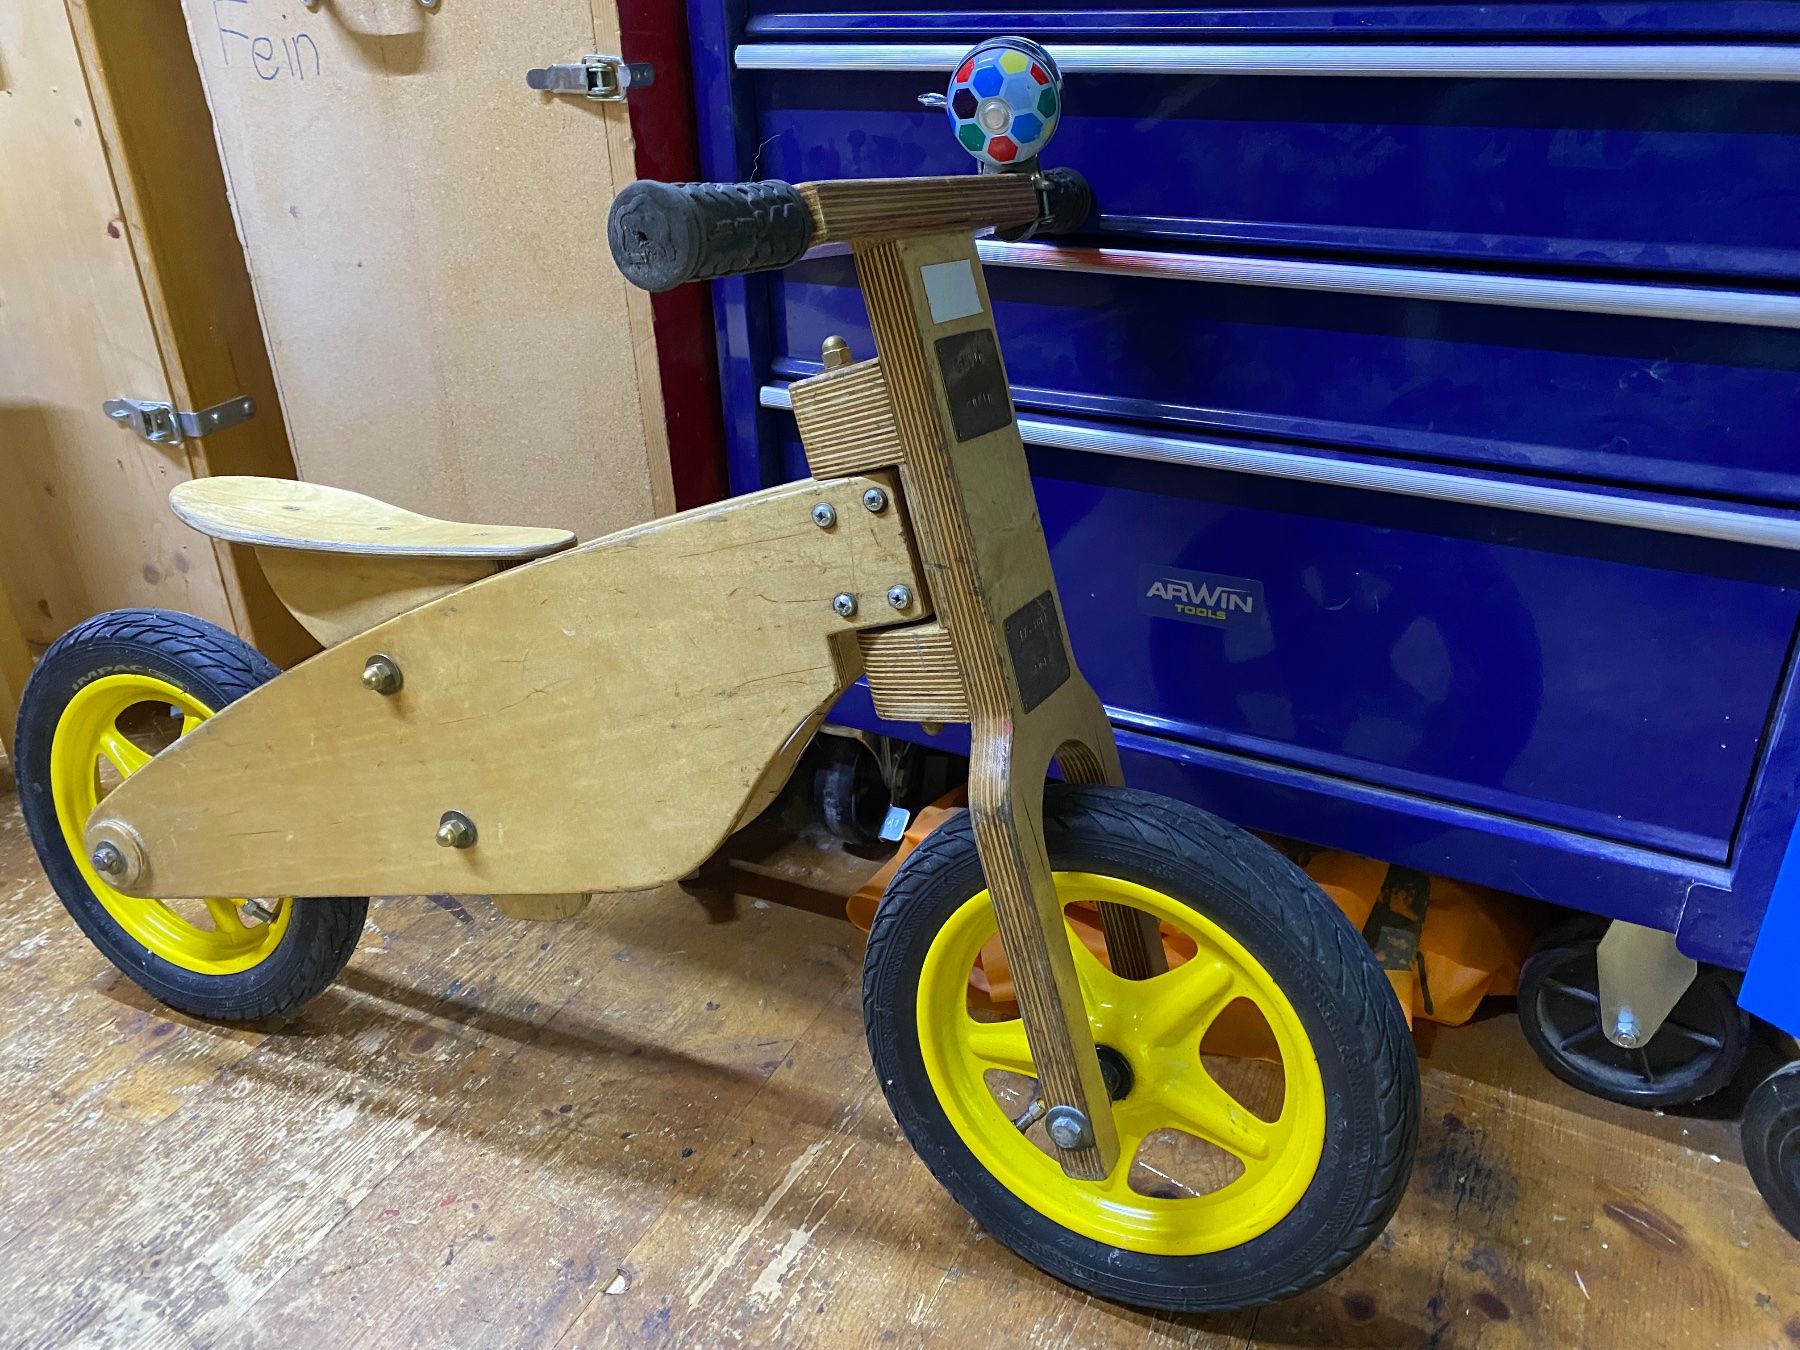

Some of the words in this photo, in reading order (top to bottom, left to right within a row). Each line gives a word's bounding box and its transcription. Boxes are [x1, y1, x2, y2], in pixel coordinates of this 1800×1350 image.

[213, 0, 320, 81] Fein
[1146, 577, 1253, 614] ARWIN
[1174, 604, 1227, 620] TOOLS
[72, 664, 145, 691] IMPAC
